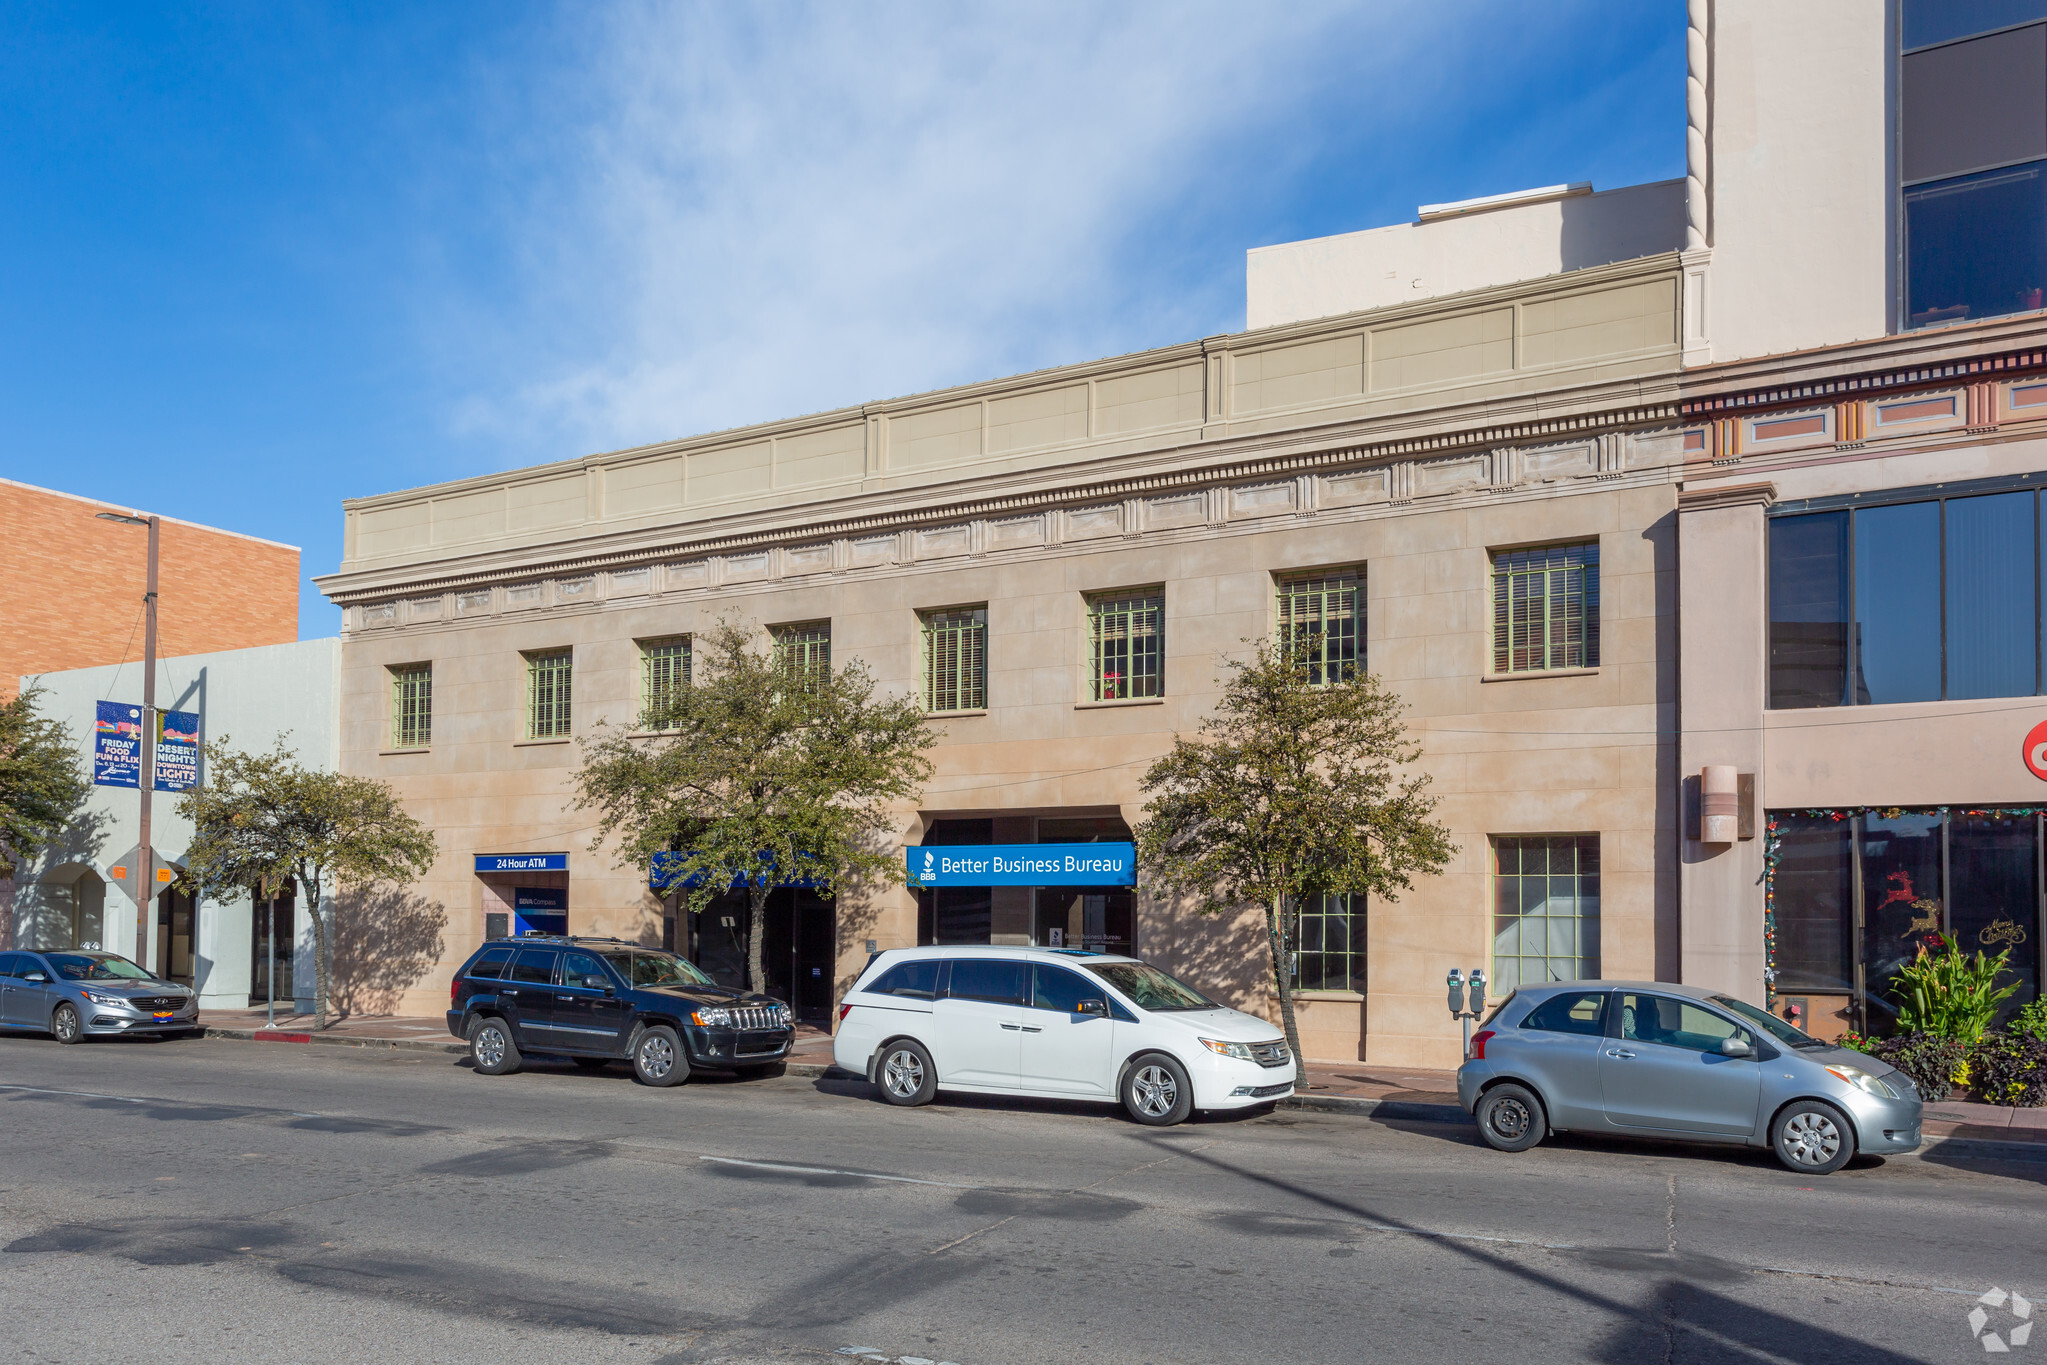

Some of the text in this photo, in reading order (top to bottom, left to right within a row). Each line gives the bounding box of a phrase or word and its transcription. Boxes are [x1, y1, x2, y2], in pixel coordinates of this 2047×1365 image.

[101, 738, 135, 749] FRIDAY
[105, 746, 130, 756] FOOD
[158, 744, 196, 756] DESERT
[96, 752, 112, 760] FUN
[120, 756, 139, 764] FLIX
[157, 752, 196, 764] NIGHTS
[156, 762, 196, 770] DOWNTOWN
[156, 768, 196, 780] LIGHTS
[496, 858, 546, 868] 24 Hour ATM
[941, 855, 1122, 873] Better Business Bureau
[920, 872, 936, 880] BBB
